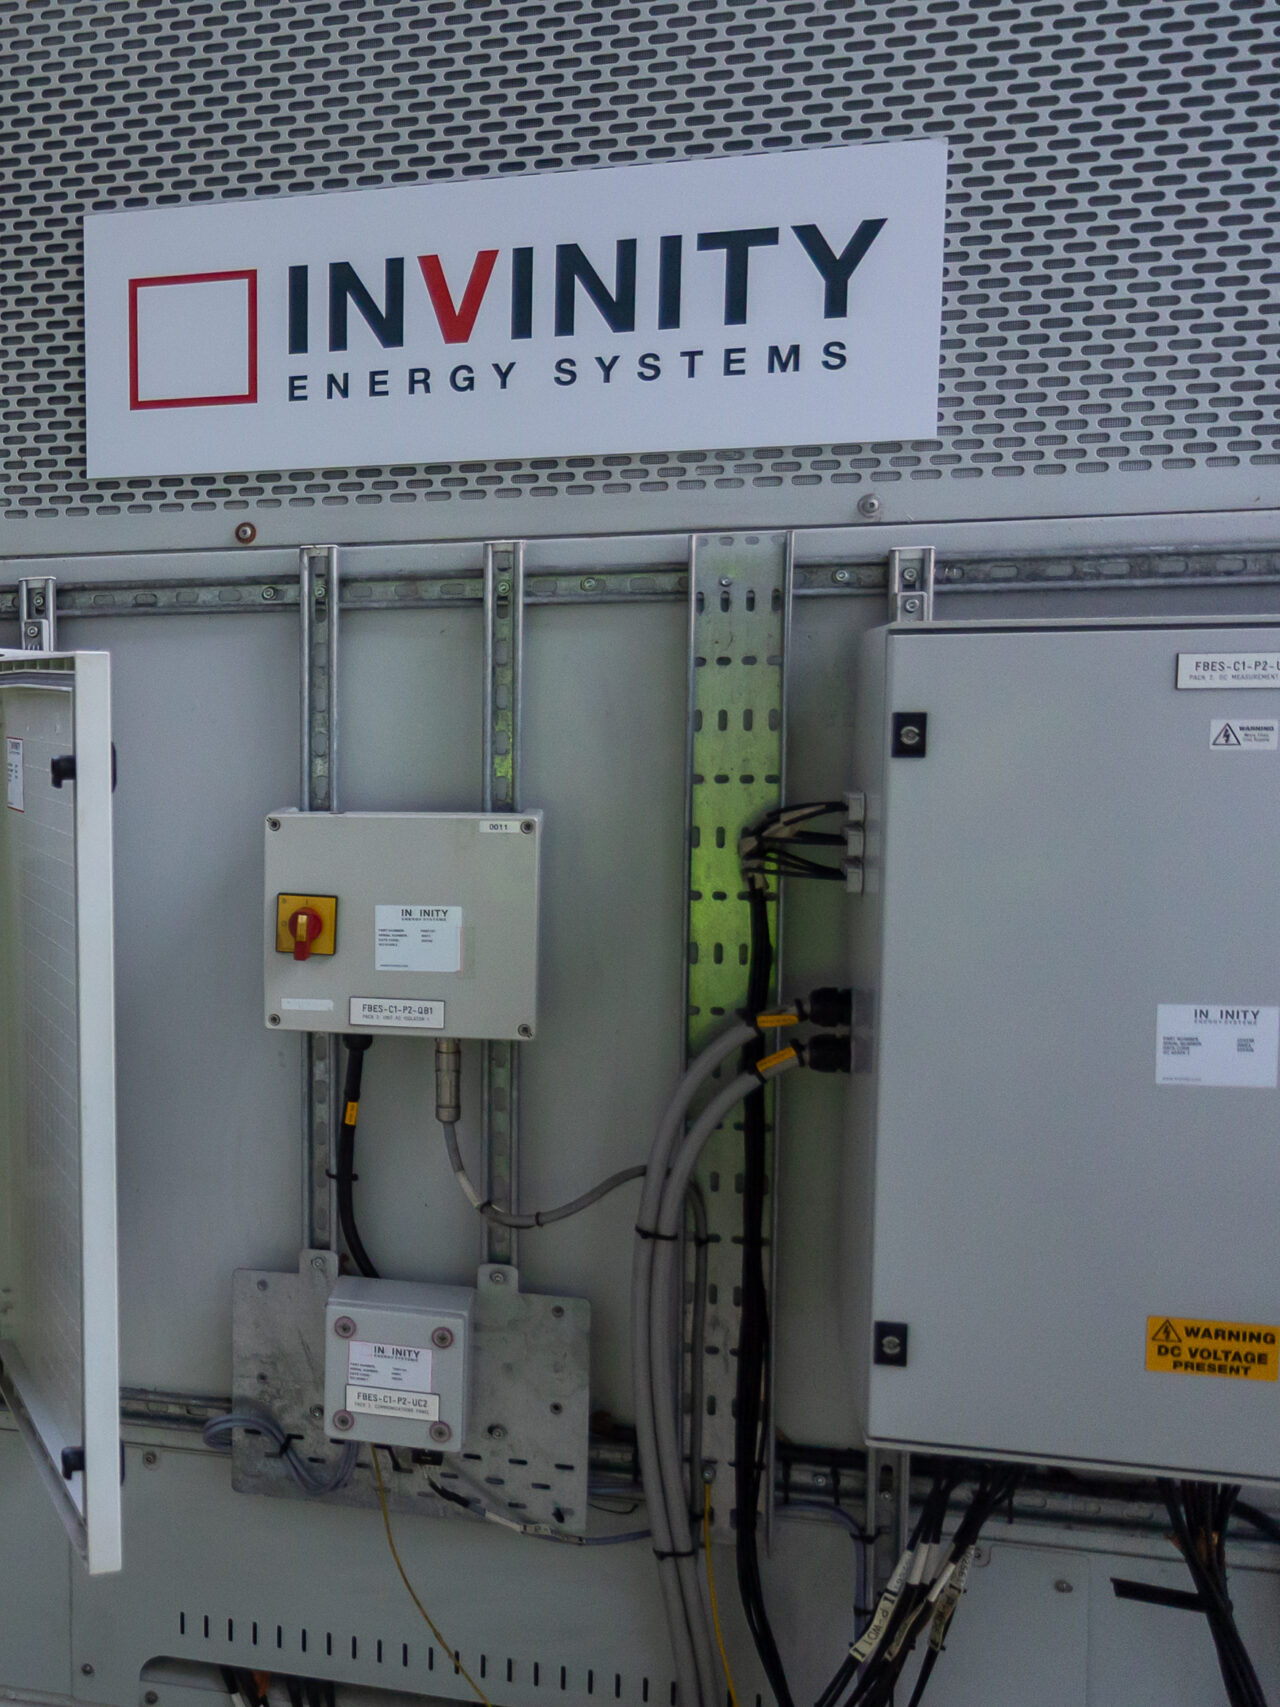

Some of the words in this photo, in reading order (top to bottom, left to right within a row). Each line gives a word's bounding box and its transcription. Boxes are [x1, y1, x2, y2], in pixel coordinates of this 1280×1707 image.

[287, 218, 888, 355] INVINITY
[288, 362, 517, 402] ENERGY
[553, 340, 850, 388] SYSTEMS
[361, 1003, 434, 1016] FBES-C1-P2-QB1
[1184, 1326, 1276, 1345] WARNING
[1157, 1345, 1182, 1358] DC
[1188, 1347, 1268, 1365] VOLTAGE
[1172, 1361, 1251, 1376] PRESENT
[357, 1392, 428, 1408] FBES-C1-P2-UC2
